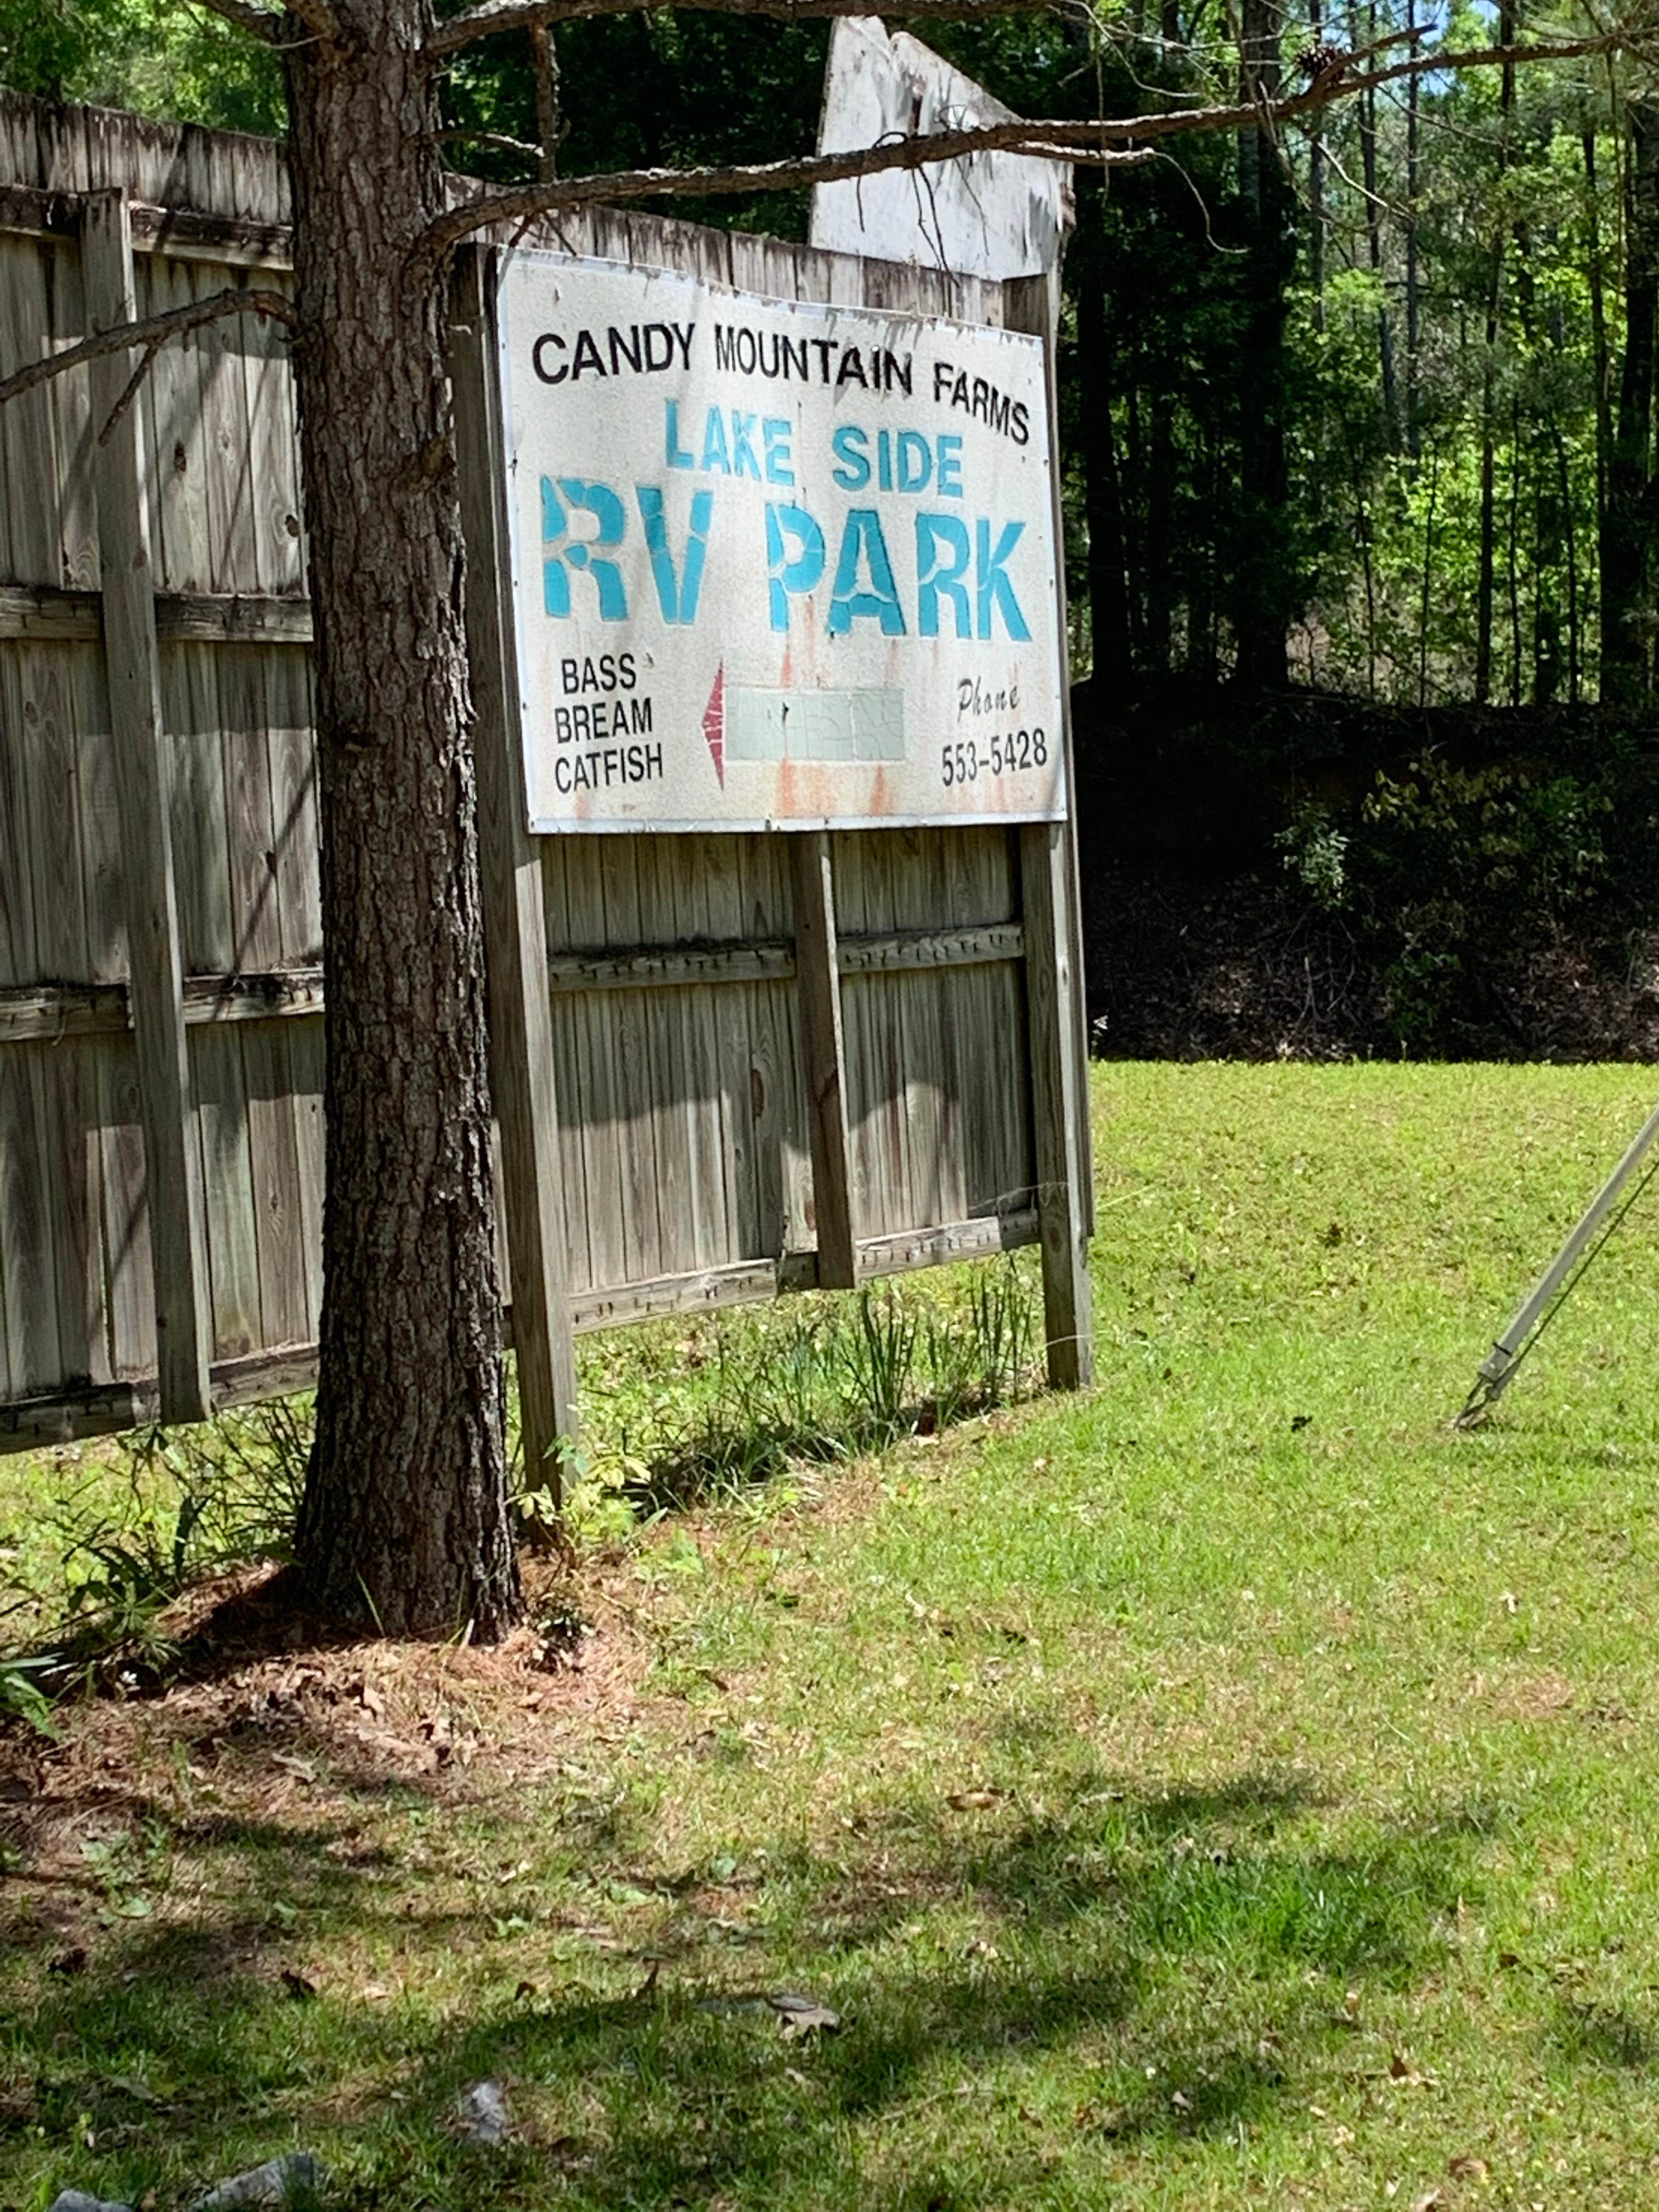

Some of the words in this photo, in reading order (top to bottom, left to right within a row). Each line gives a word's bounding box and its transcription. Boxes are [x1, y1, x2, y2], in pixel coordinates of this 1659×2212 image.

[533, 322, 696, 384] CANDY
[715, 323, 913, 395] MOUNTAIN
[933, 363, 1029, 445] FARMS
[665, 398, 794, 487] LAKE
[832, 426, 963, 498] SIDE
[540, 475, 713, 625] RV
[766, 500, 1032, 642] PARK
[562, 653, 636, 694] BASS
[957, 676, 1020, 723] Phone
[555, 698, 652, 743] BREAM
[555, 743, 663, 794] CATFISH
[941, 727, 1047, 787] 553-5428
